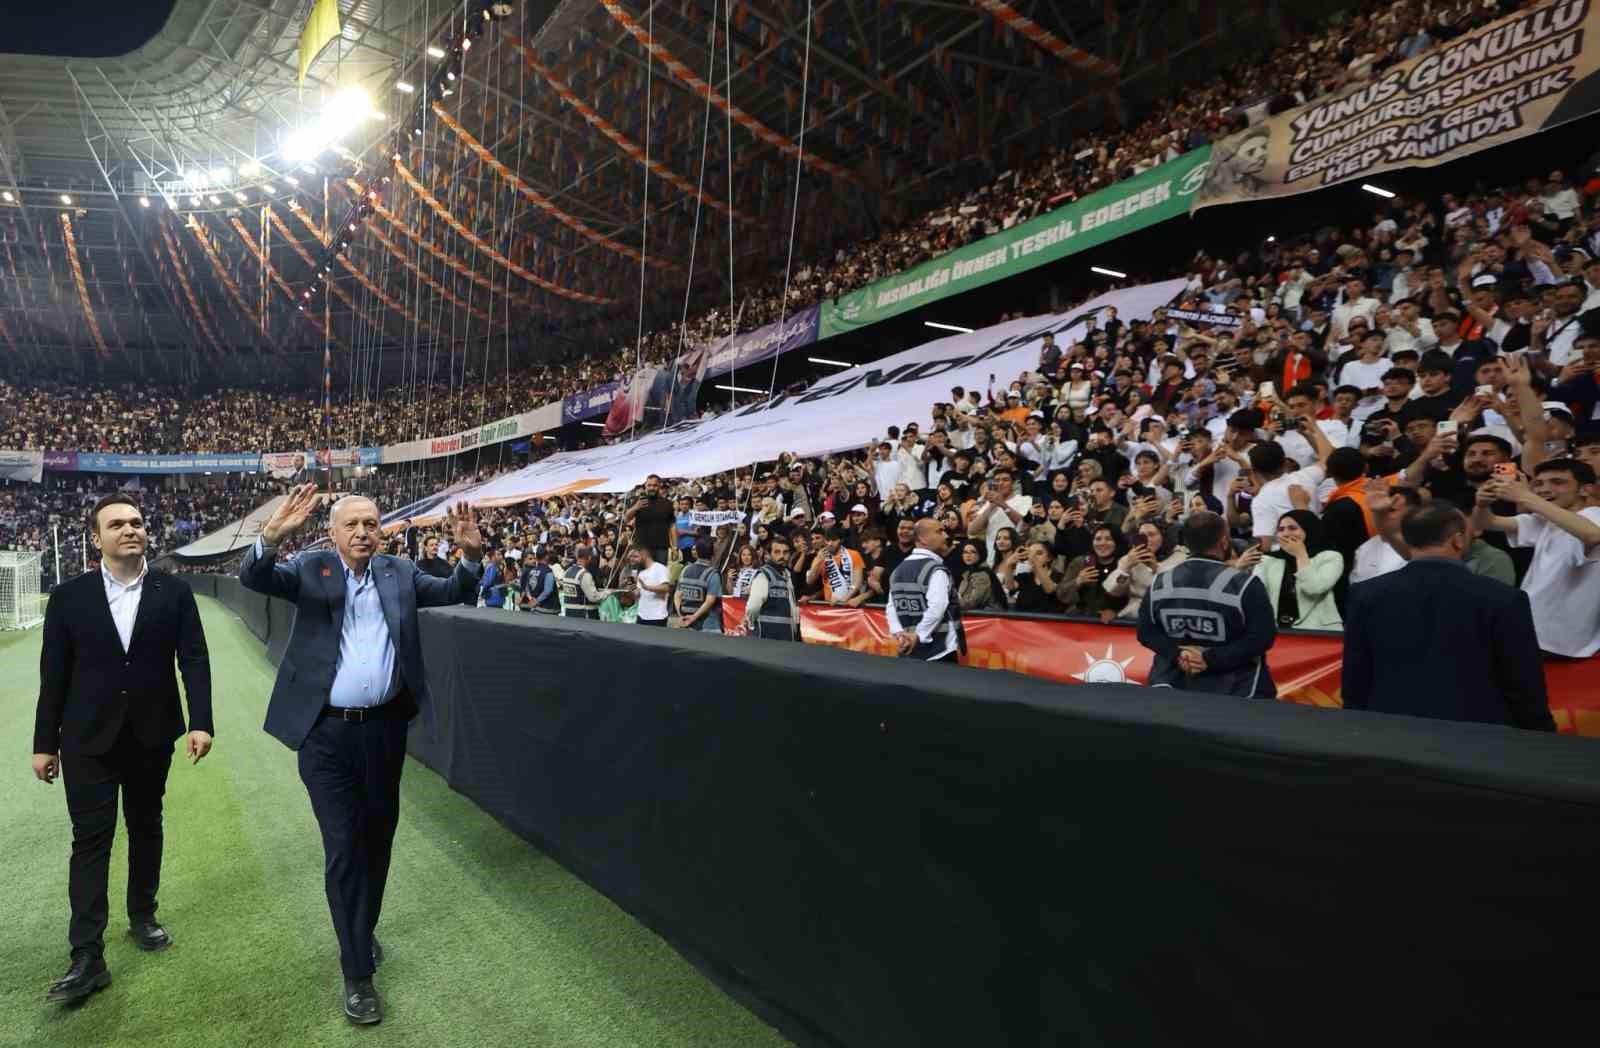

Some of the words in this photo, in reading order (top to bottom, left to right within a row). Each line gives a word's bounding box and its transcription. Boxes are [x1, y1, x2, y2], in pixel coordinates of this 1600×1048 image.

[1293, 33, 1577, 163] CUMHURBAŞKANIM
[1294, 71, 1401, 141] YUNUS
[1408, 0, 1585, 90] GÖNÜLLÜ
[1402, 118, 1438, 141] AK
[1441, 70, 1569, 128] GENÇLİK
[1325, 149, 1381, 184] HEP
[1385, 110, 1516, 160] YANINDA
[1080, 180, 1173, 233] EDECEK
